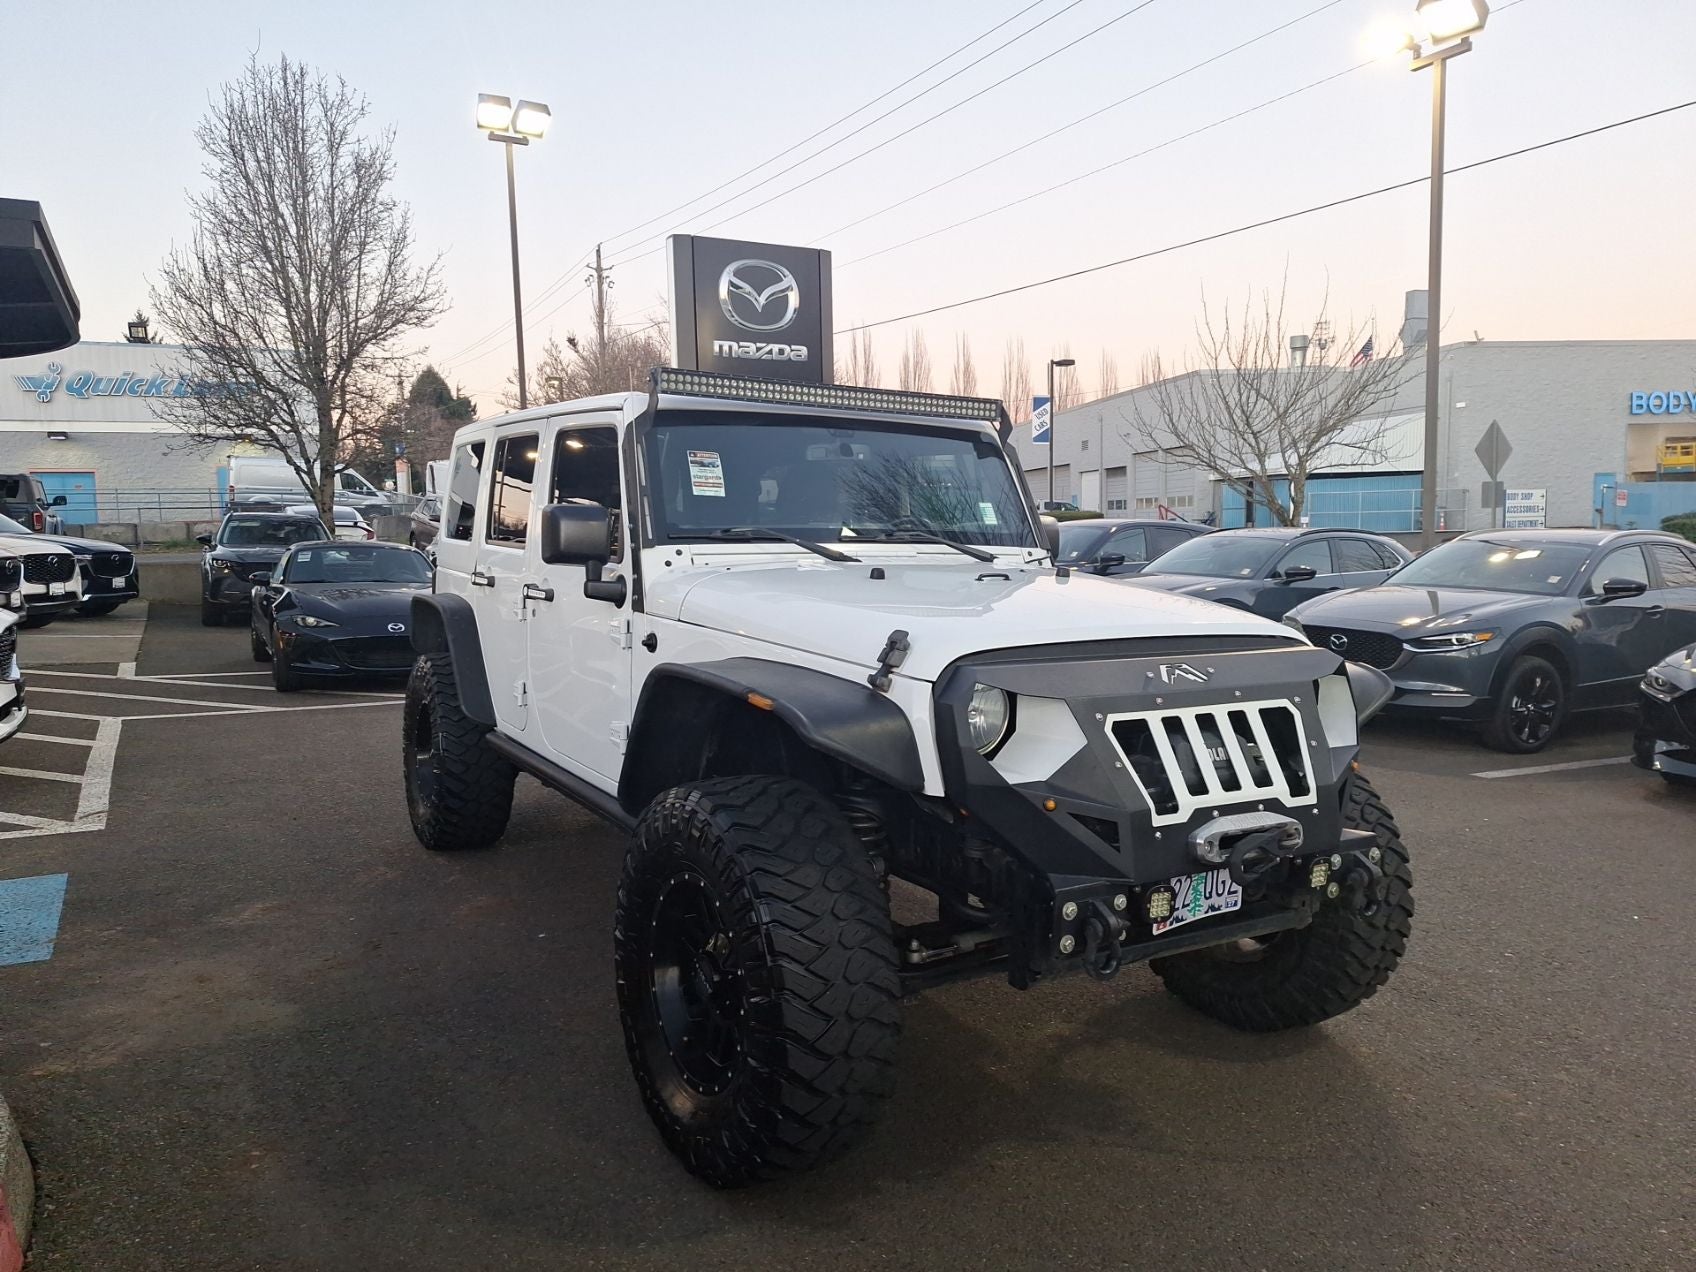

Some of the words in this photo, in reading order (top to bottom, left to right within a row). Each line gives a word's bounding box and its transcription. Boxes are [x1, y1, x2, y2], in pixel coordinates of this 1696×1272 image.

[64, 369, 170, 399] Quick
[1035, 407, 1049, 420] USED
[1034, 420, 1048, 432] CARS
[1507, 492, 1520, 501] BODY
[1521, 492, 1534, 501] SHOP
[1507, 505, 1539, 513] ACCESSORIES
[1173, 874, 1192, 911] 22
